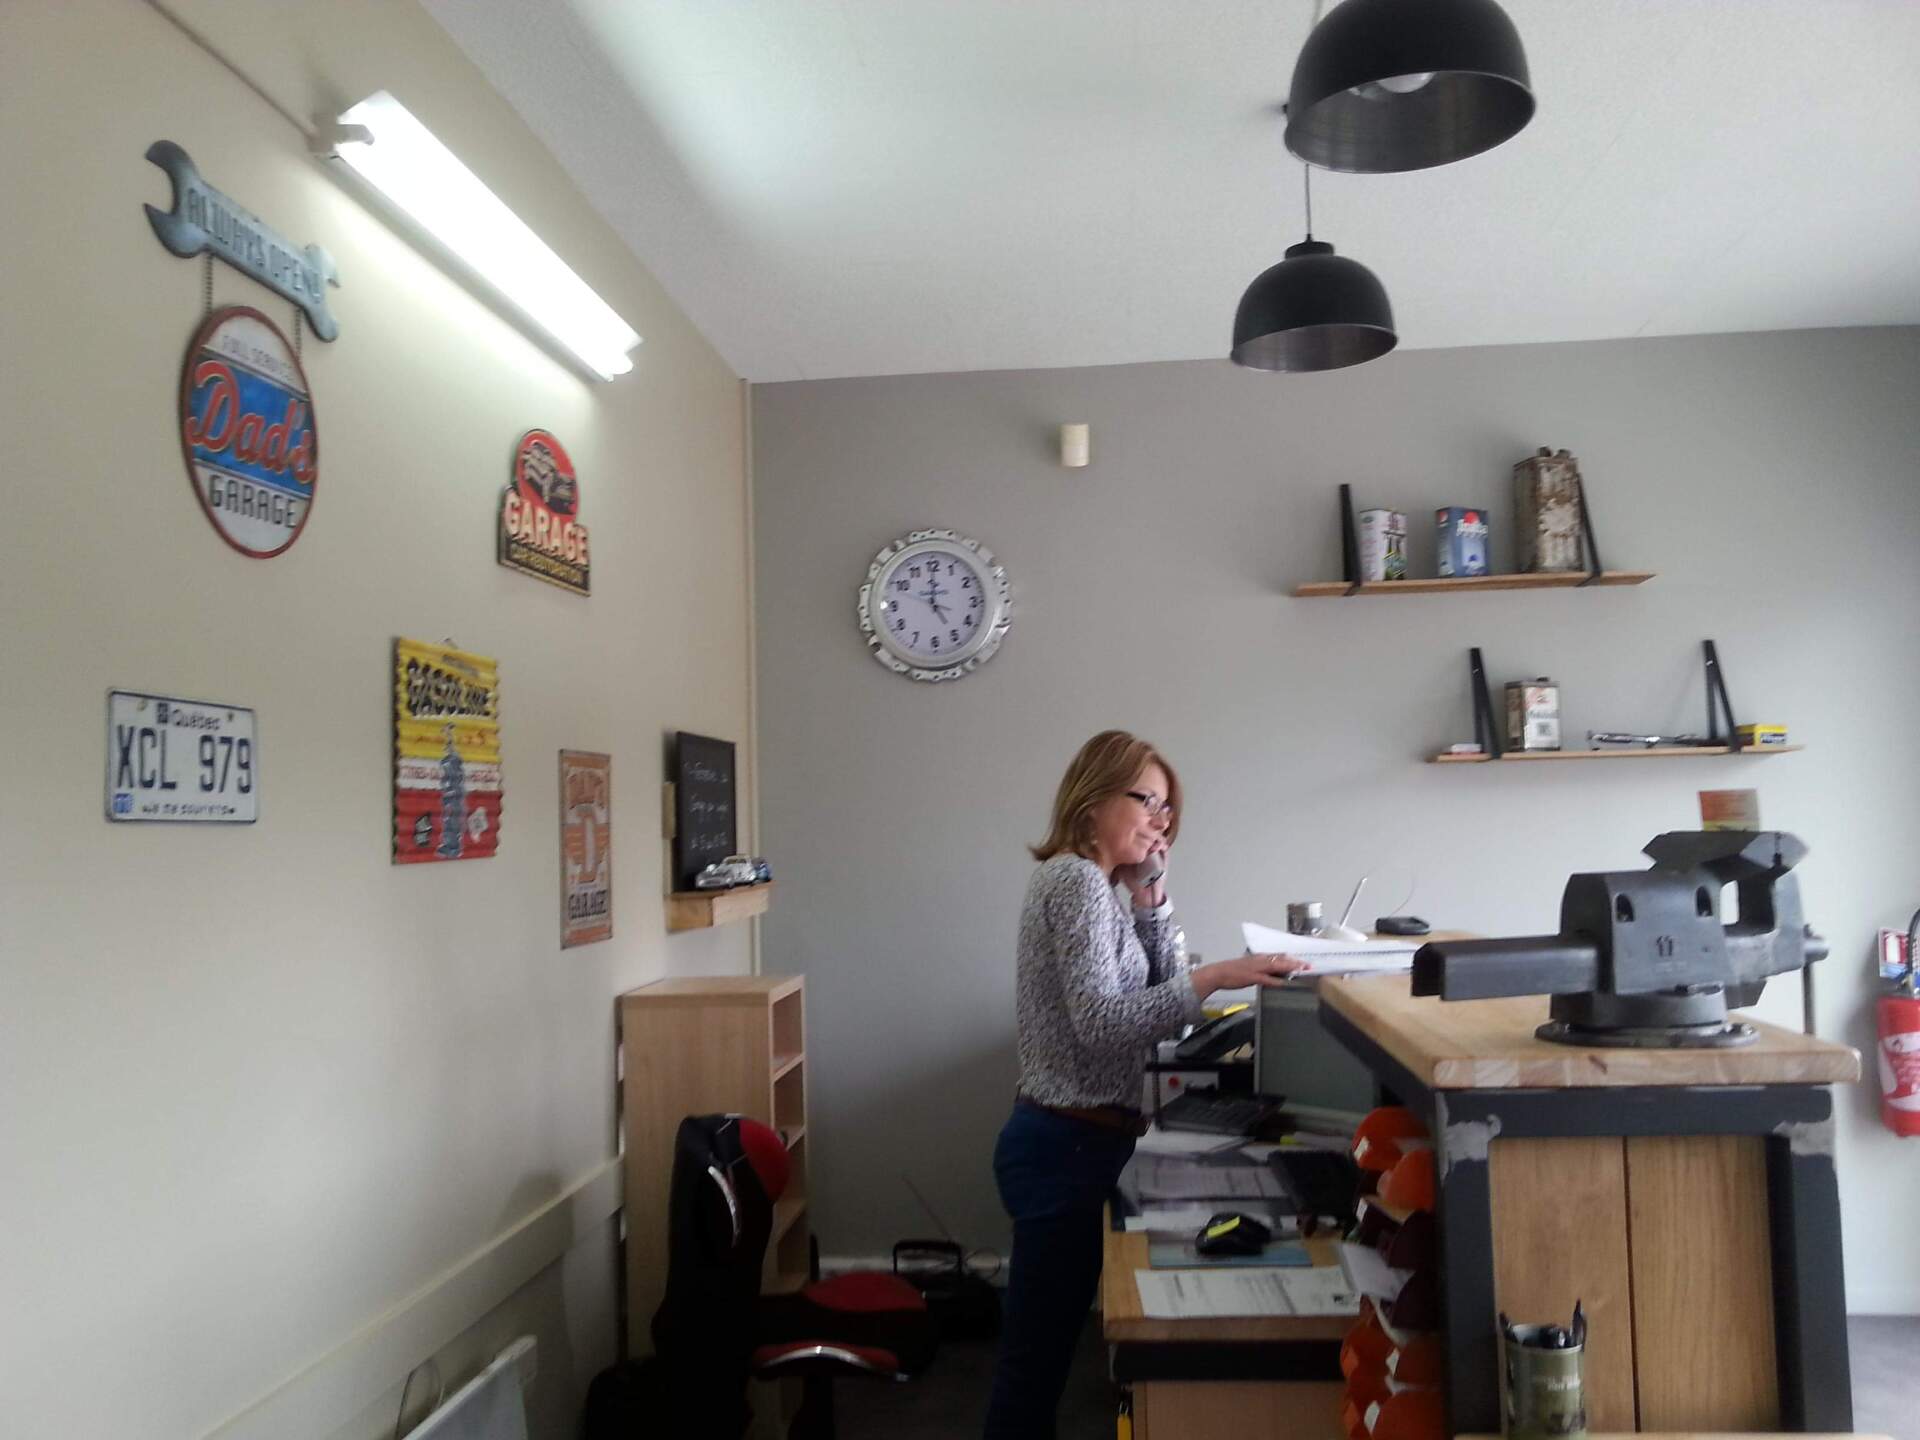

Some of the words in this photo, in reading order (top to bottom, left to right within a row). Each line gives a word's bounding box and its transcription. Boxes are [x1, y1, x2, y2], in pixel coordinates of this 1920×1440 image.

[185, 360, 315, 484] Dad's
[209, 474, 298, 529] GARAGE
[504, 486, 589, 567] GARAGE
[116, 723, 178, 790] XCL
[199, 734, 252, 795] 979
